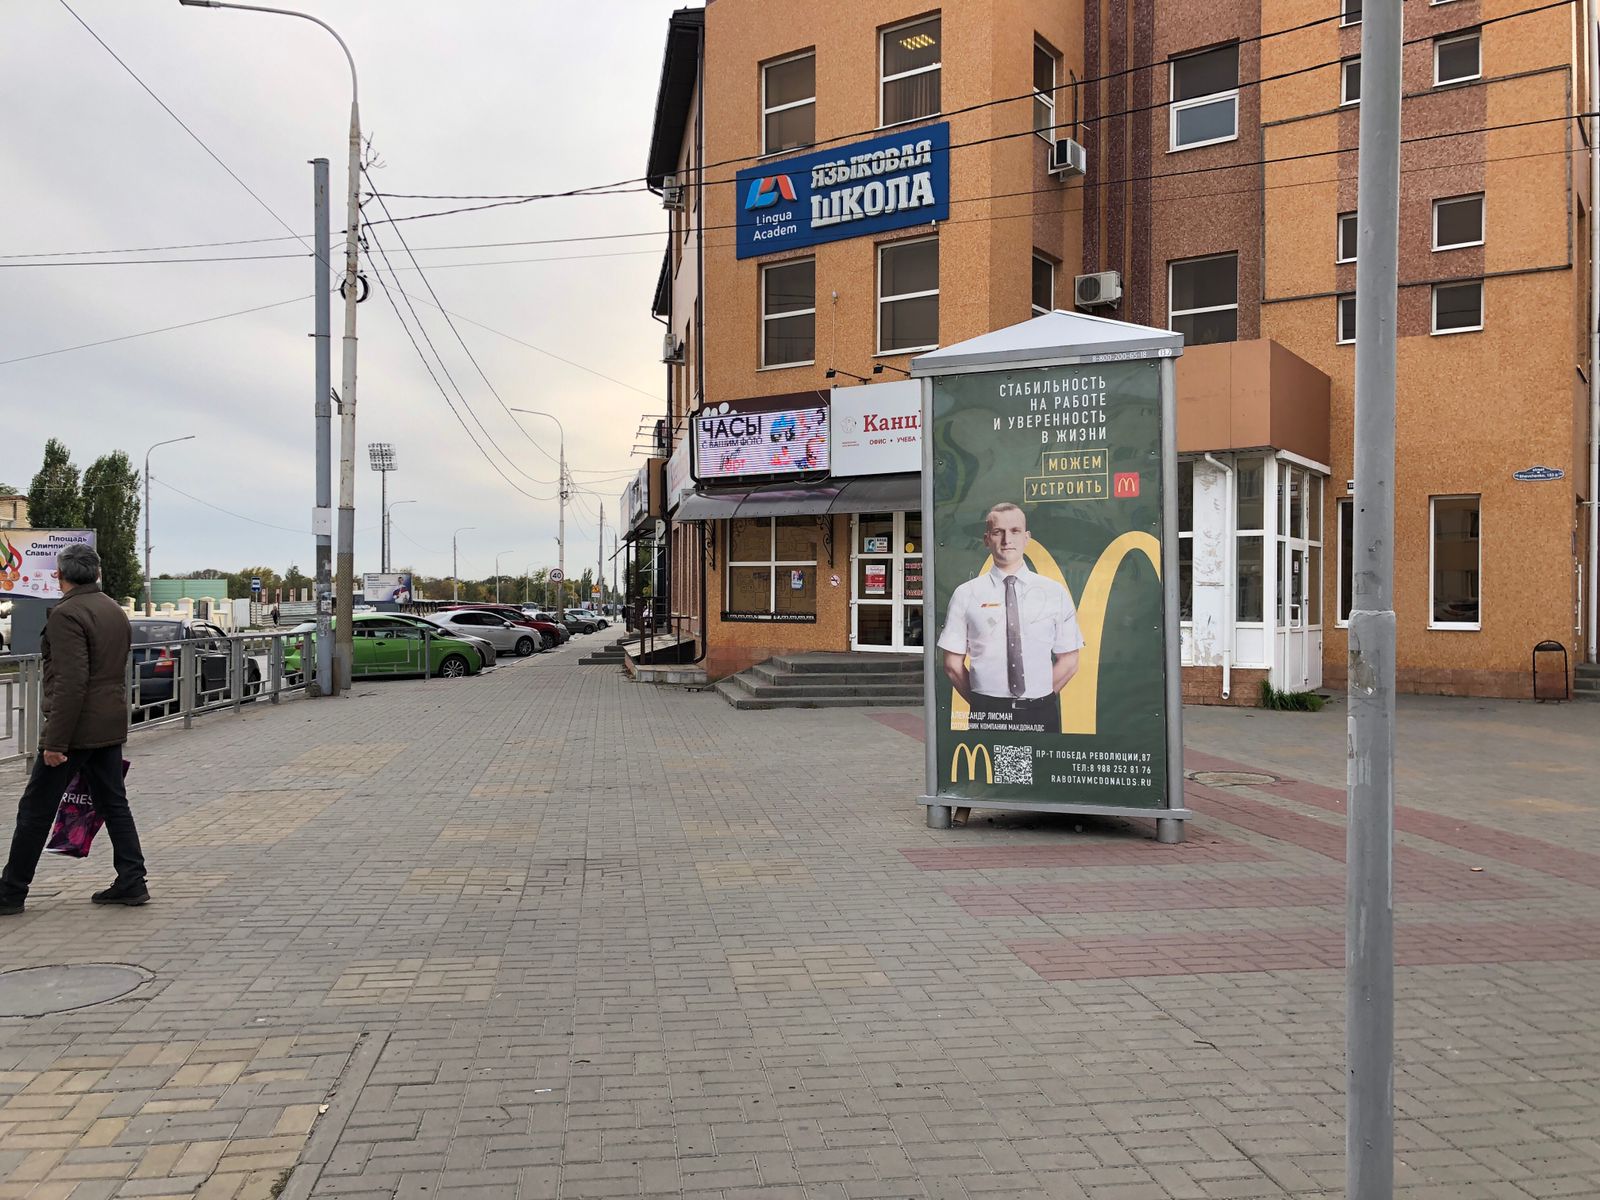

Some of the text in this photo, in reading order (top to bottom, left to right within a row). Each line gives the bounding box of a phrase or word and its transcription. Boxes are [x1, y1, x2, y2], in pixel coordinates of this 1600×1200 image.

[811, 139, 932, 189] ЯЗЫКОВАЯ
[811, 171, 935, 228] ШКОЛА
[756, 211, 792, 227] Lingua
[753, 225, 797, 241] Academ
[1092, 351, 1147, 362] 8-800-200-65-18
[999, 376, 1106, 397] СТАБИЛЬНОСТЬ
[1030, 393, 1106, 411] НА РАБОТЕ
[702, 415, 762, 439] ЧАСЫ
[993, 411, 1106, 430] И УВЕРЕННОСТЬ
[702, 437, 763, 449] С ВАШИМ ФОТО
[1041, 427, 1107, 444] В ЖИЗНИ
[1048, 455, 1101, 471] МОЖЕМ
[1031, 479, 1102, 496] УСТРОИТЬ
[49, 535, 88, 543] Площадь
[987, 712, 1013, 721] ЛИСМАН
[1035, 750, 1151, 762] ПР-Т ПОБЕДА РЕВОЛЮЦИИ,87
[1072, 764, 1151, 774] ТЕЛ:8 988 252 81 76
[1051, 774, 1152, 787] RABOTAVMCDONALDS.RU
